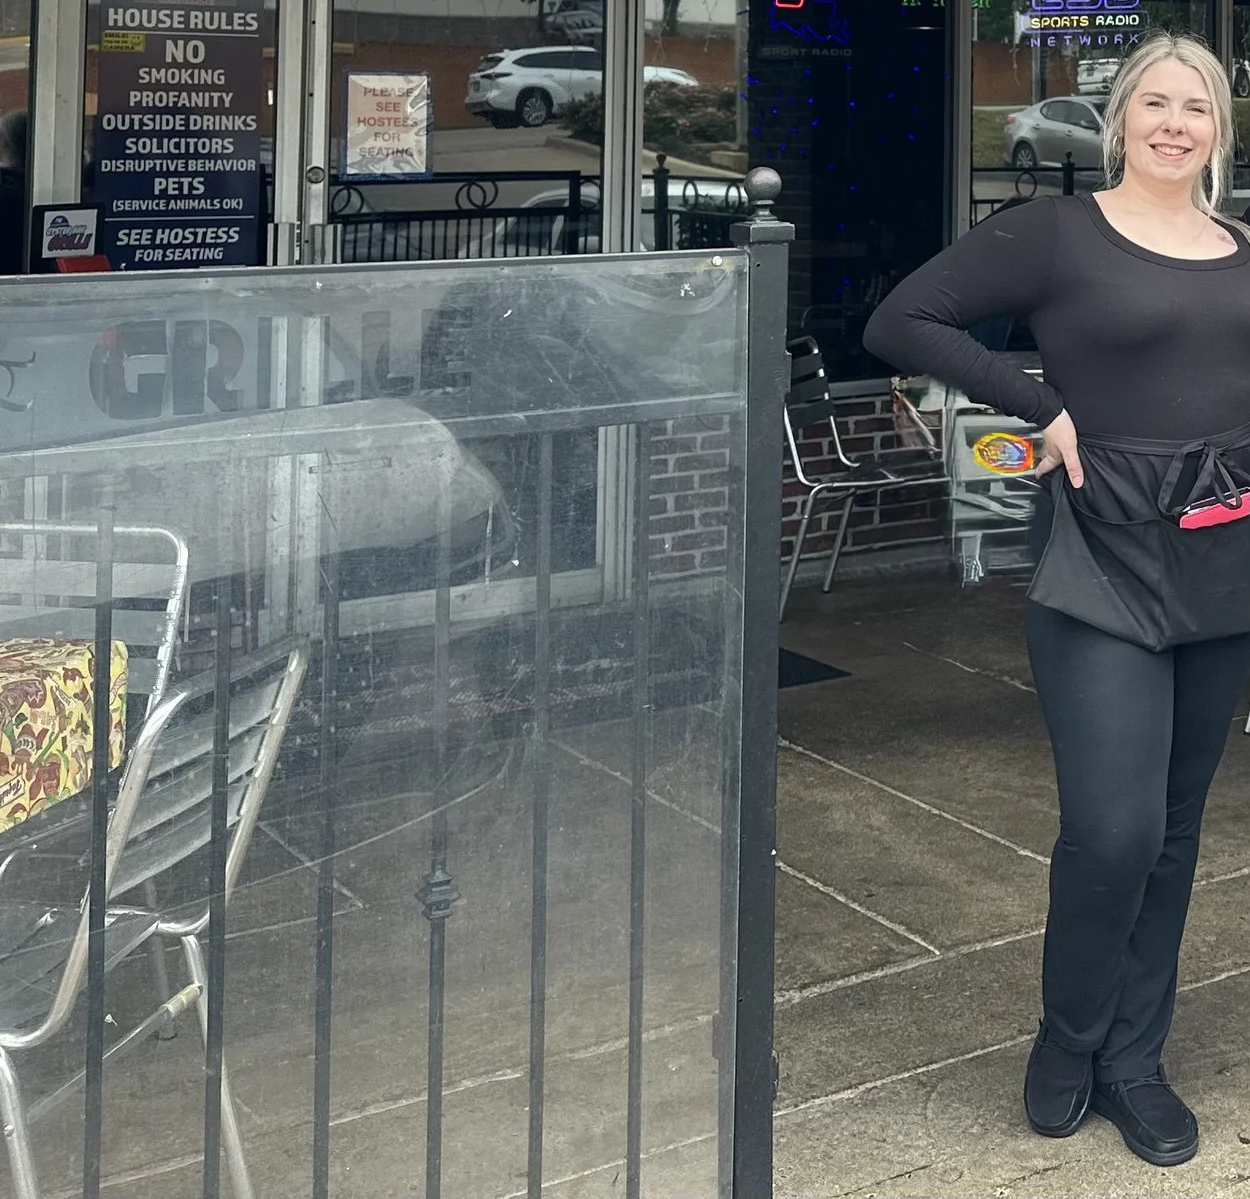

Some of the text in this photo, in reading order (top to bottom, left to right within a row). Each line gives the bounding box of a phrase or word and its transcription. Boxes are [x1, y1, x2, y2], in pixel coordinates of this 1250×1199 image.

[108, 8, 259, 31] HOUSE RULES
[1031, 15, 1140, 28] SPORTS RADIO
[1031, 33, 1139, 47] NETWORK
[165, 40, 205, 64] NO
[138, 68, 225, 85] SMOKING
[363, 87, 414, 97] PLEASE
[129, 91, 233, 108] PROFANITY
[376, 102, 400, 112] SEE
[102, 114, 257, 131] OUTSIDE DRINKS
[357, 117, 418, 127] HOSTESS
[374, 132, 400, 142] FOR
[125, 138, 234, 154] SOLICITORS
[359, 146, 414, 157] SEATING
[101, 159, 256, 172] DISRUPTIVE BEHAVIOR
[154, 177, 205, 195] PETS
[113, 198, 243, 212] (SERVICE ANIMALS OK)
[116, 227, 240, 245] SEE HOSTESS
[134, 248, 224, 262] FOR SEATING
